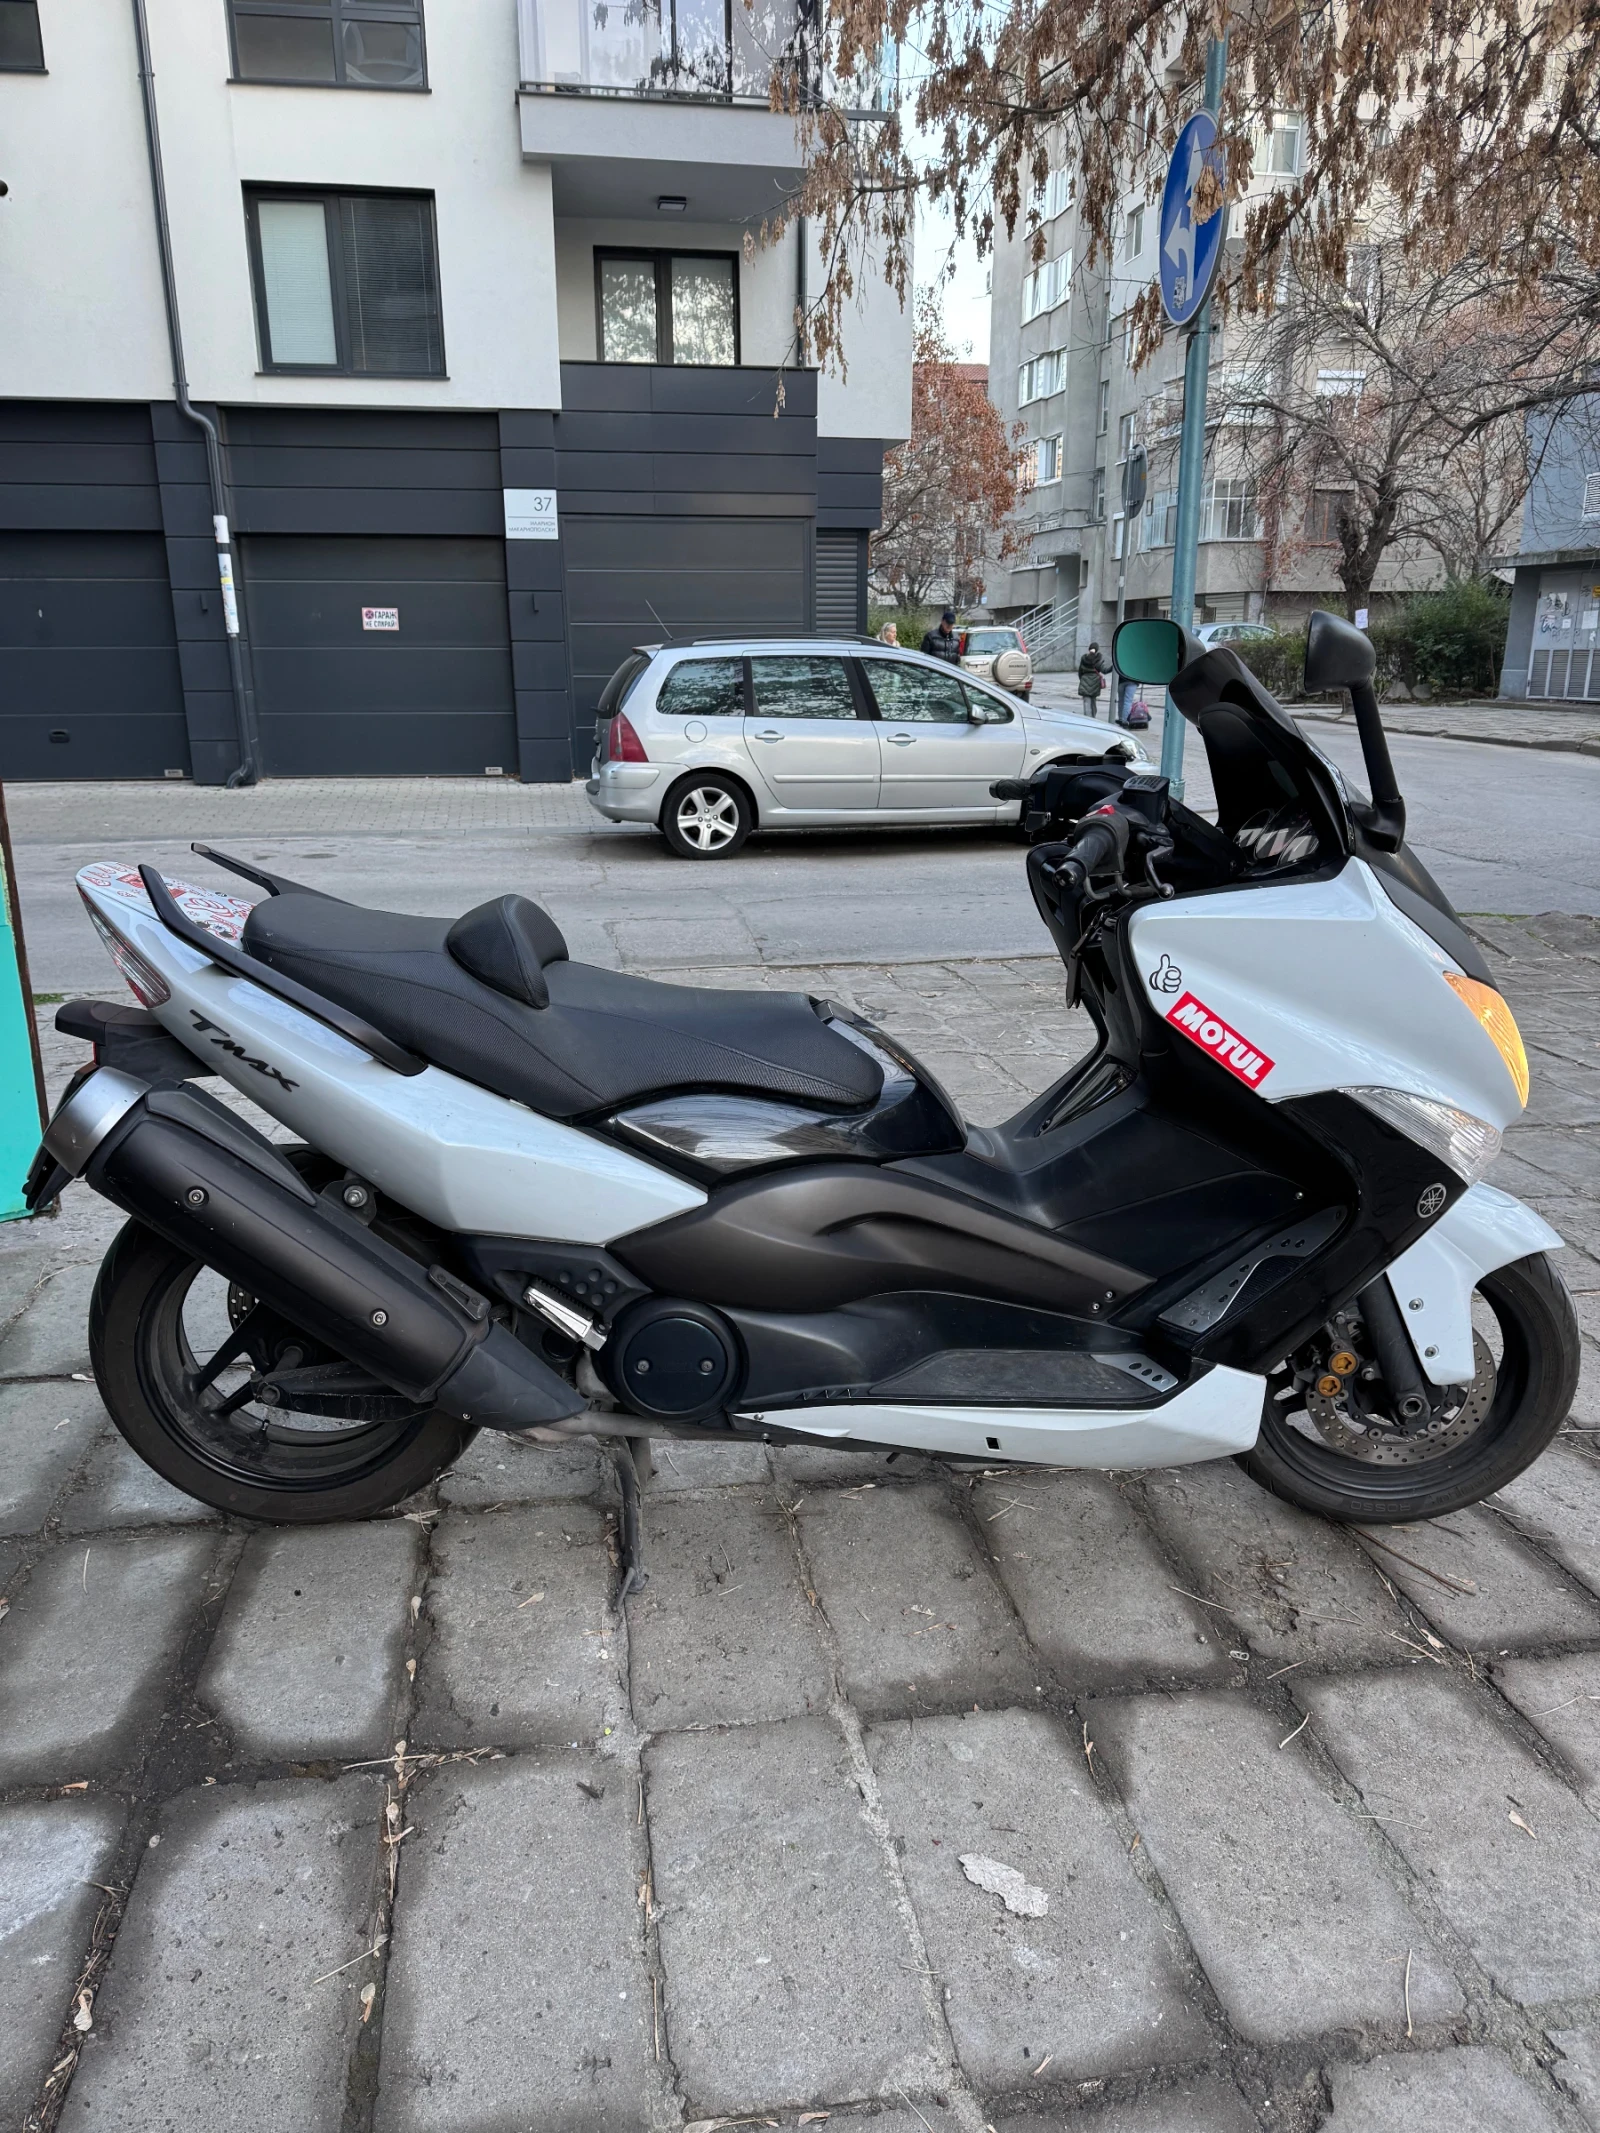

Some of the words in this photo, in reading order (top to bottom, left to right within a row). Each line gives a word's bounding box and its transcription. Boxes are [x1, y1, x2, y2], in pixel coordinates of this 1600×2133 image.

[533, 496, 552, 511] 37
[374, 610, 397, 619] ГАРАЖ
[1173, 1002, 1266, 1081] MOTUL
[189, 1009, 300, 1093] TMAX
[1350, 1500, 1412, 1513] ROSSO
